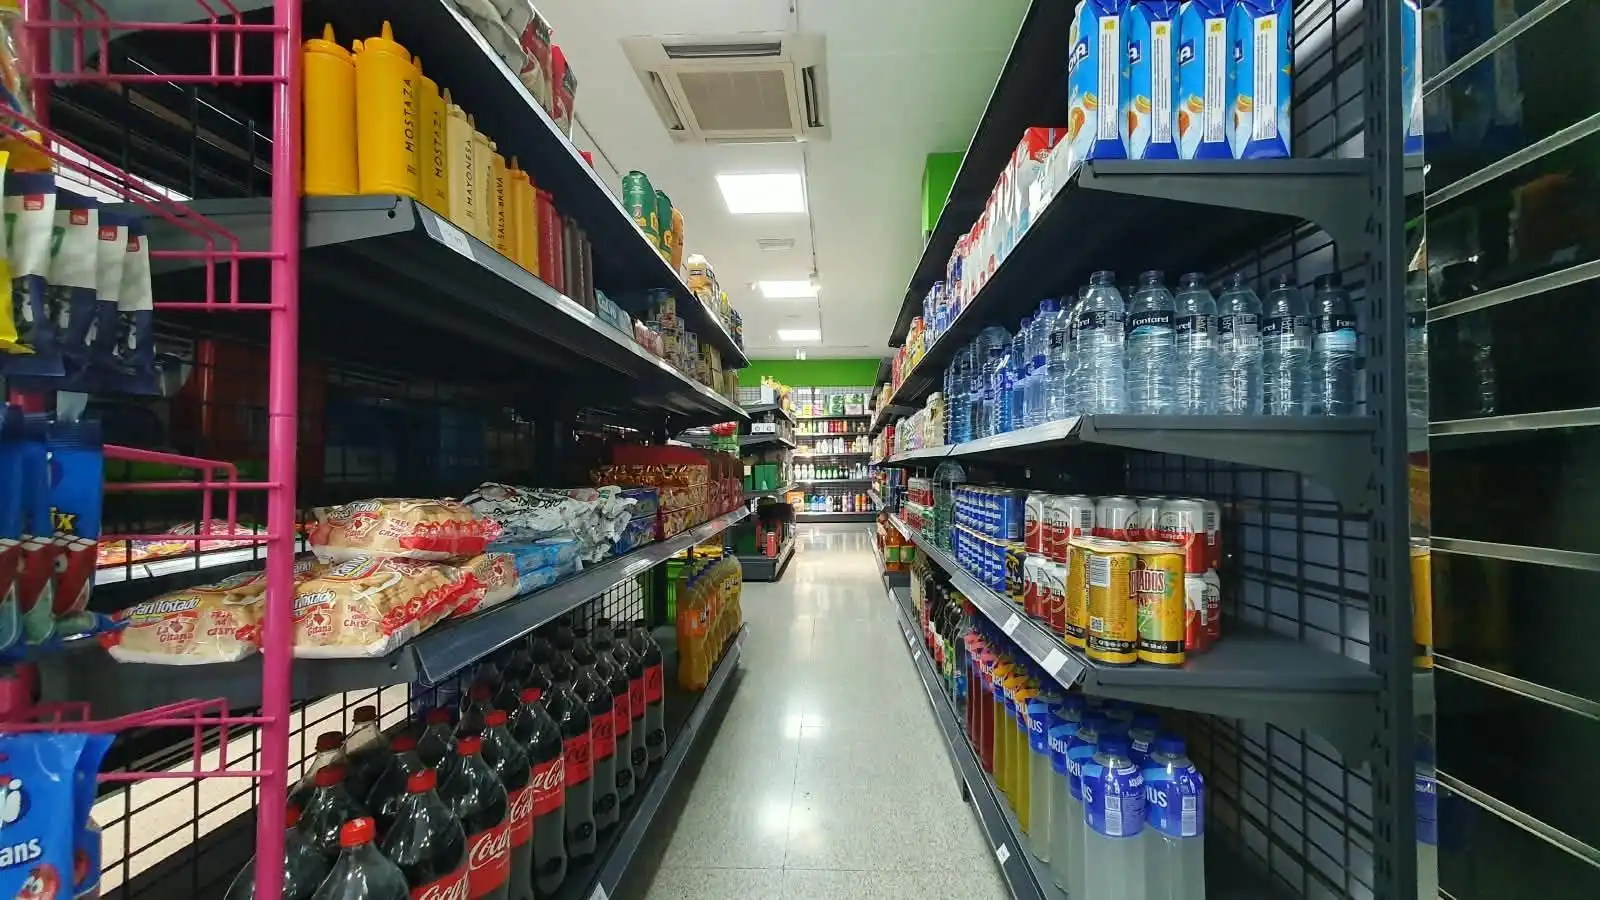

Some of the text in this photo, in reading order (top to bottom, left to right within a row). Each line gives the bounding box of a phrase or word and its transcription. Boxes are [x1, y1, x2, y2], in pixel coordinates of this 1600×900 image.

[403, 79, 414, 153] MOSTAZA
[433, 111, 443, 178] MOSTAZA
[464, 140, 474, 206] MAYONESA
[497, 211, 505, 239] SALSA
